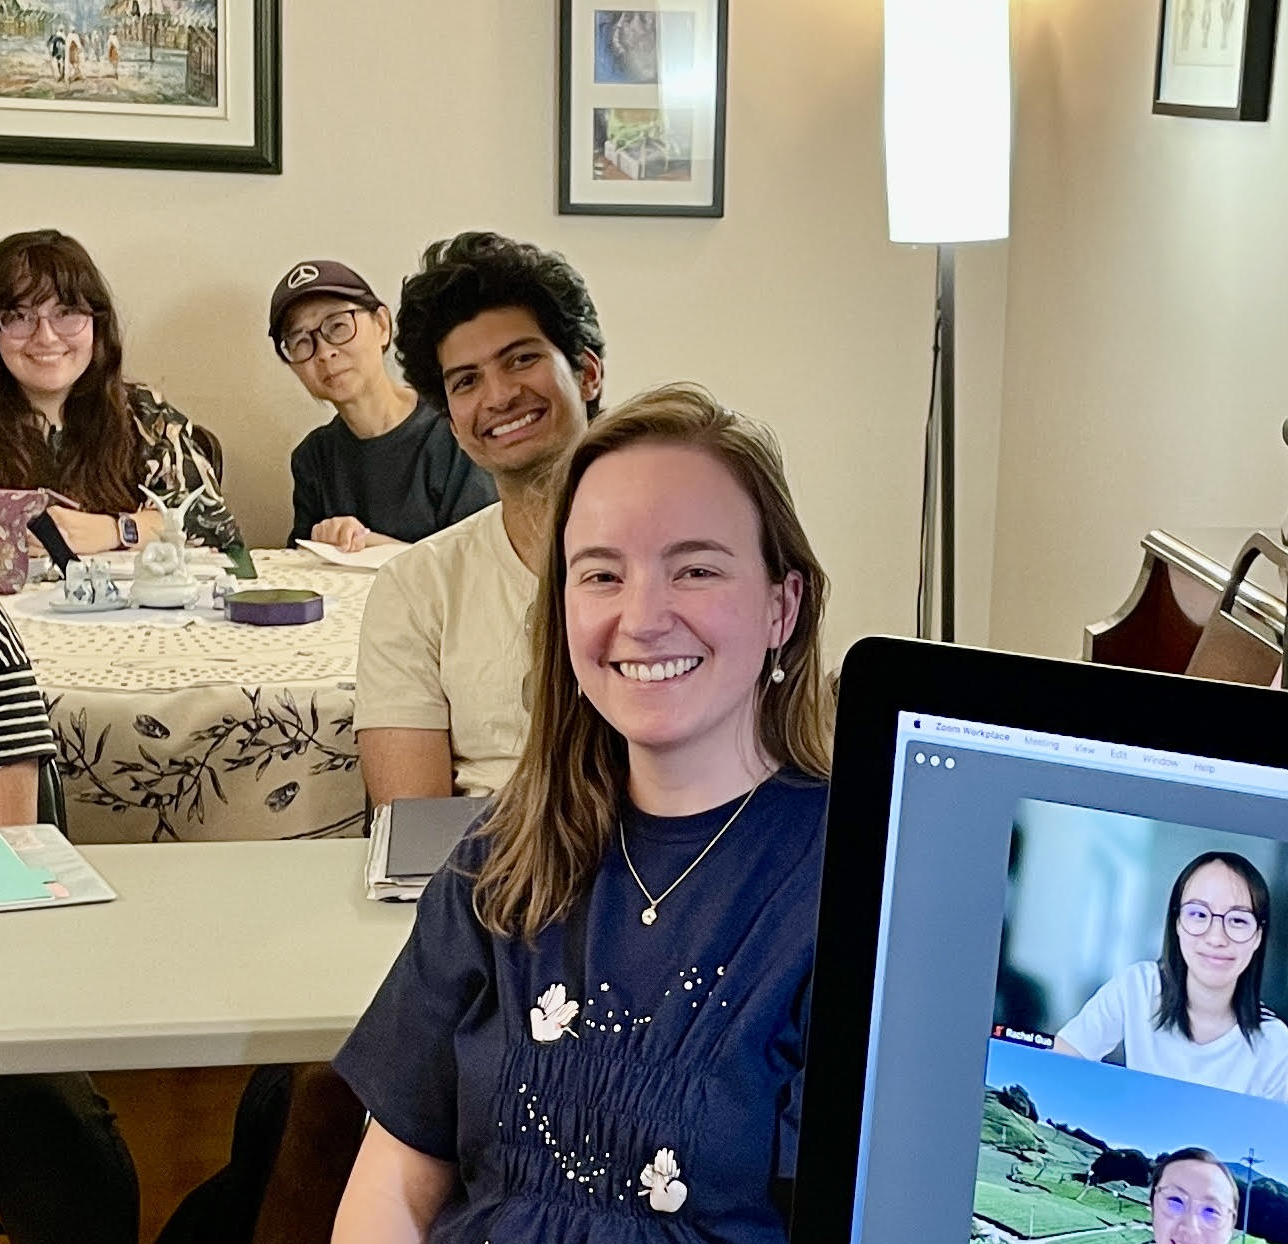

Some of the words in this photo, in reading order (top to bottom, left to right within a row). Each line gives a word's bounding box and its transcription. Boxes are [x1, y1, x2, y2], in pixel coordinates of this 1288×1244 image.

[935, 721, 961, 735] Zoom
[962, 725, 1010, 742] Workplace
[1023, 734, 1060, 751] Meeting
[1074, 743, 1096, 755] View
[1110, 748, 1127, 760] Edit
[1142, 753, 1179, 768] Window
[1193, 761, 1216, 774] Help
